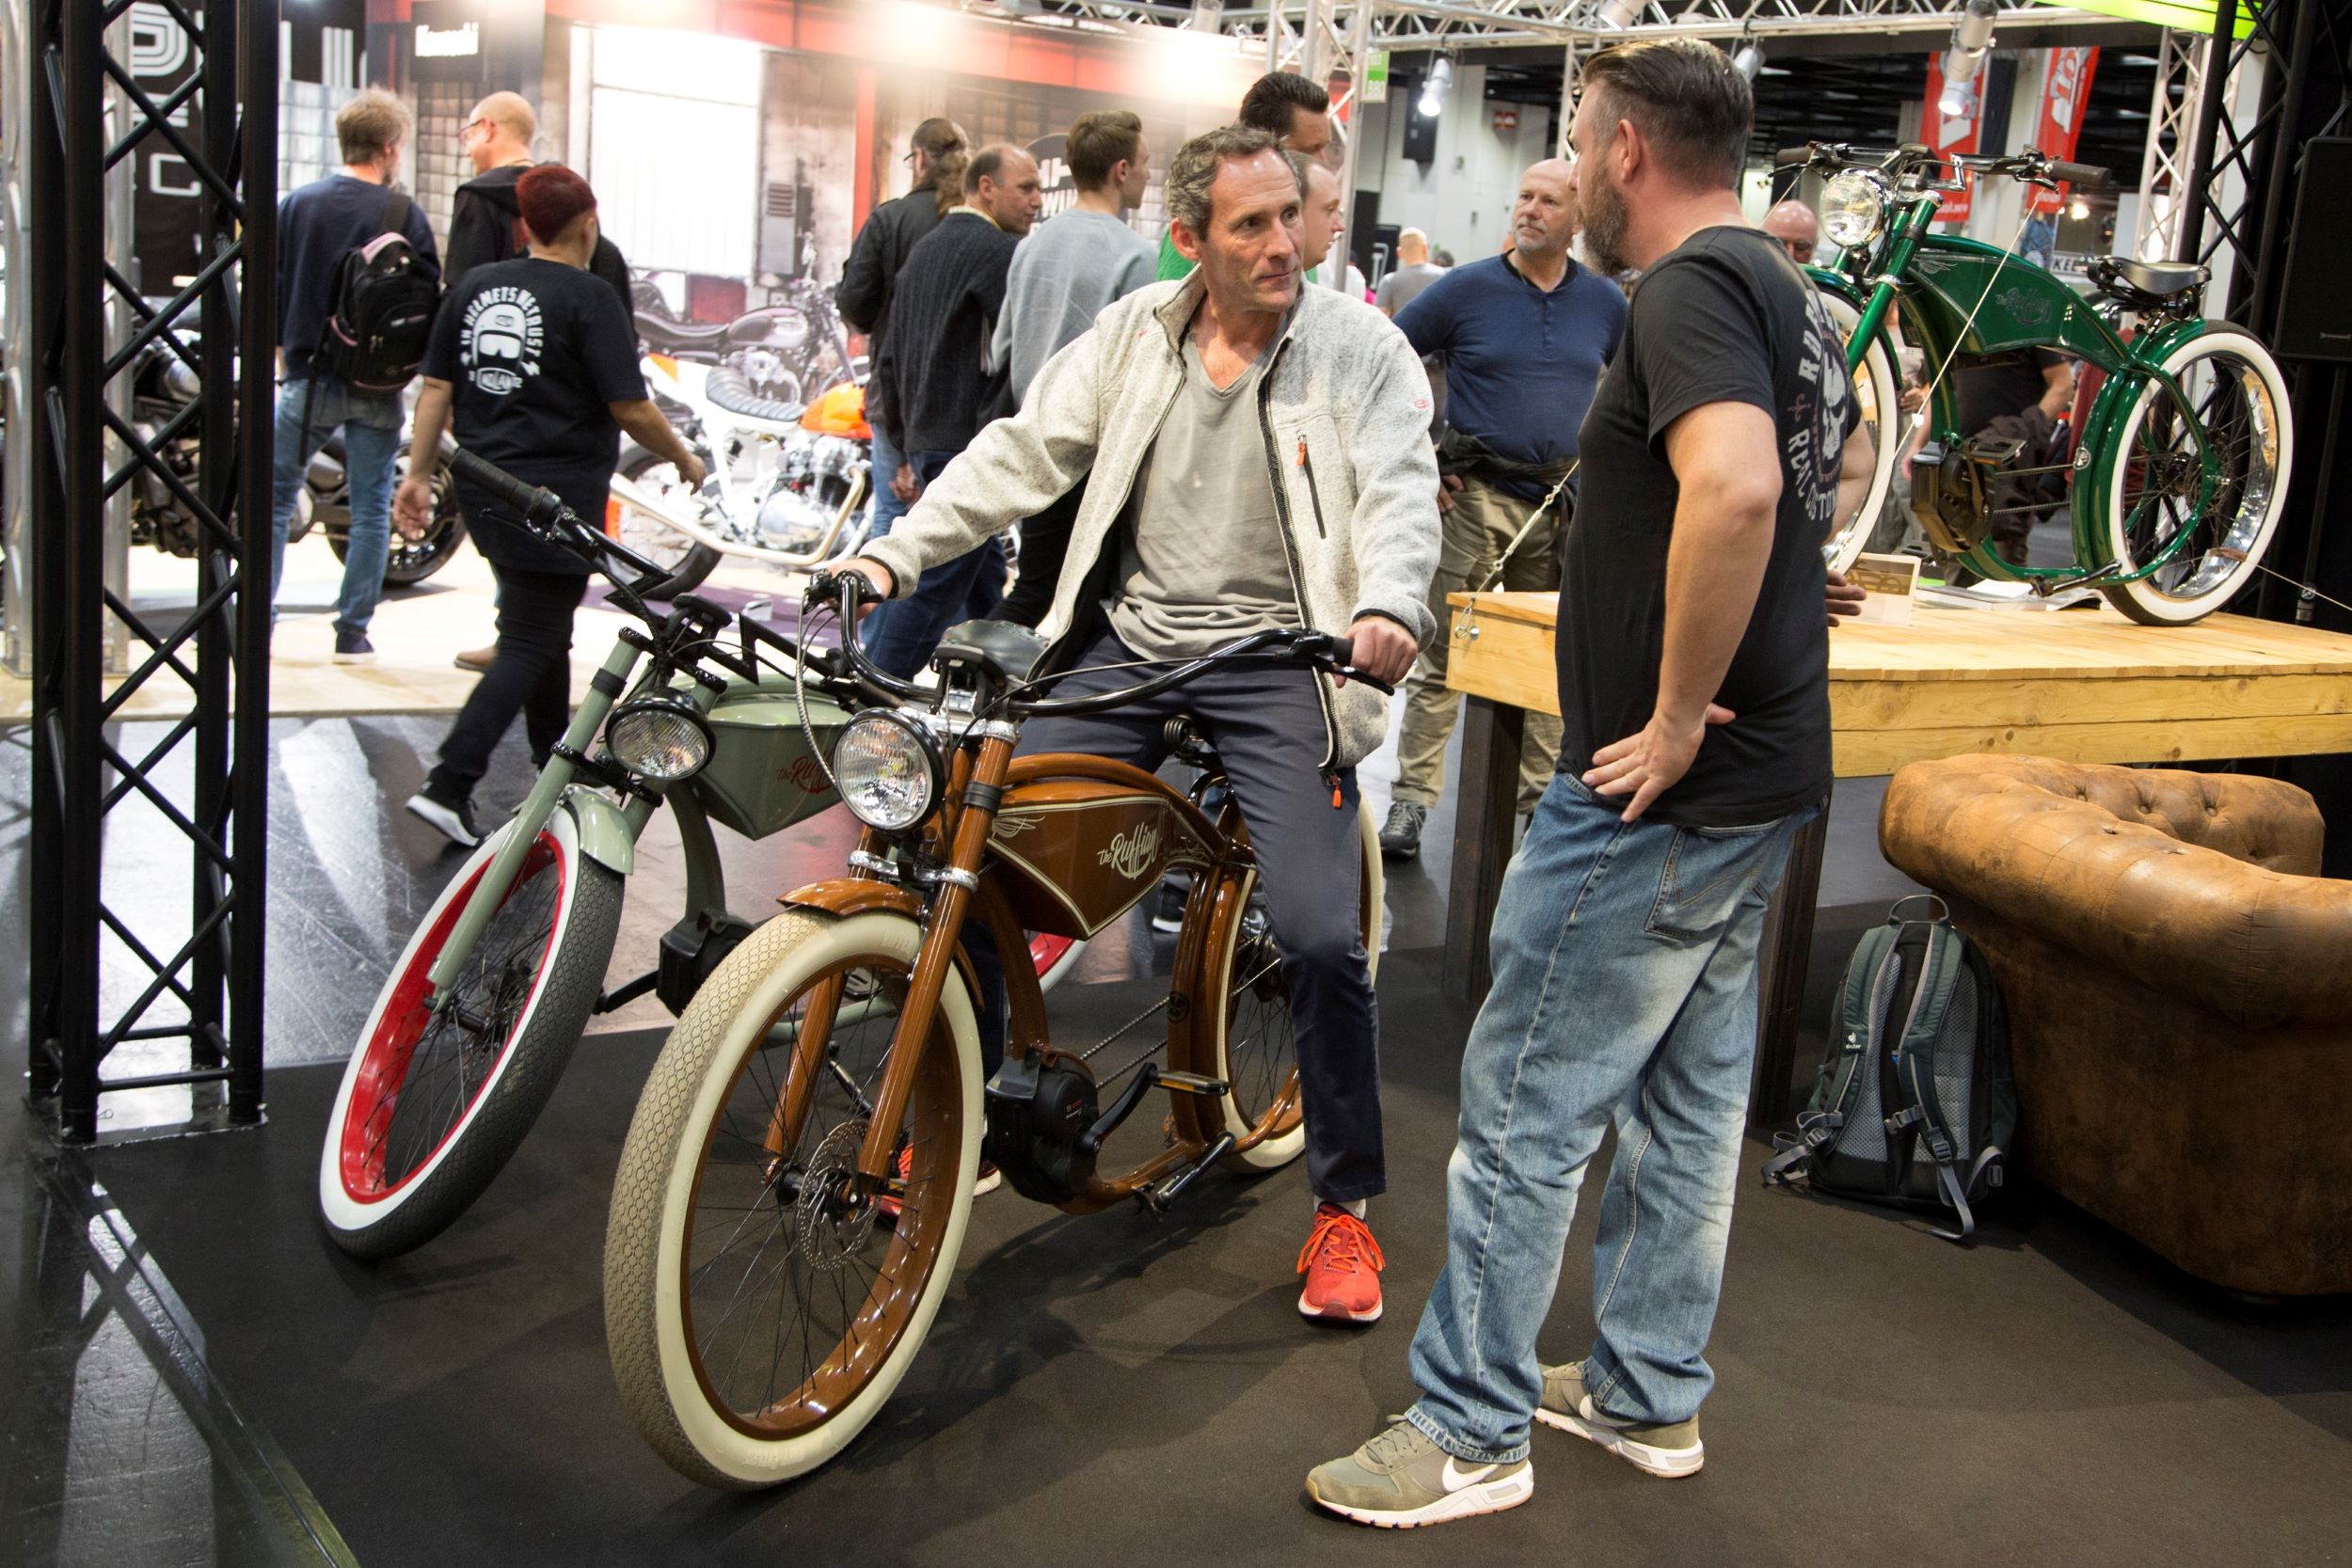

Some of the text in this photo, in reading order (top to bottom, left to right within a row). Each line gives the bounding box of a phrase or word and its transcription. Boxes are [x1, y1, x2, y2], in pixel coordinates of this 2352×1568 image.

[463, 286, 518, 326] HELMETS
[525, 306, 544, 356] TRUST
[1788, 428, 1815, 498] REAL
[1110, 821, 1158, 880] Ruffian
